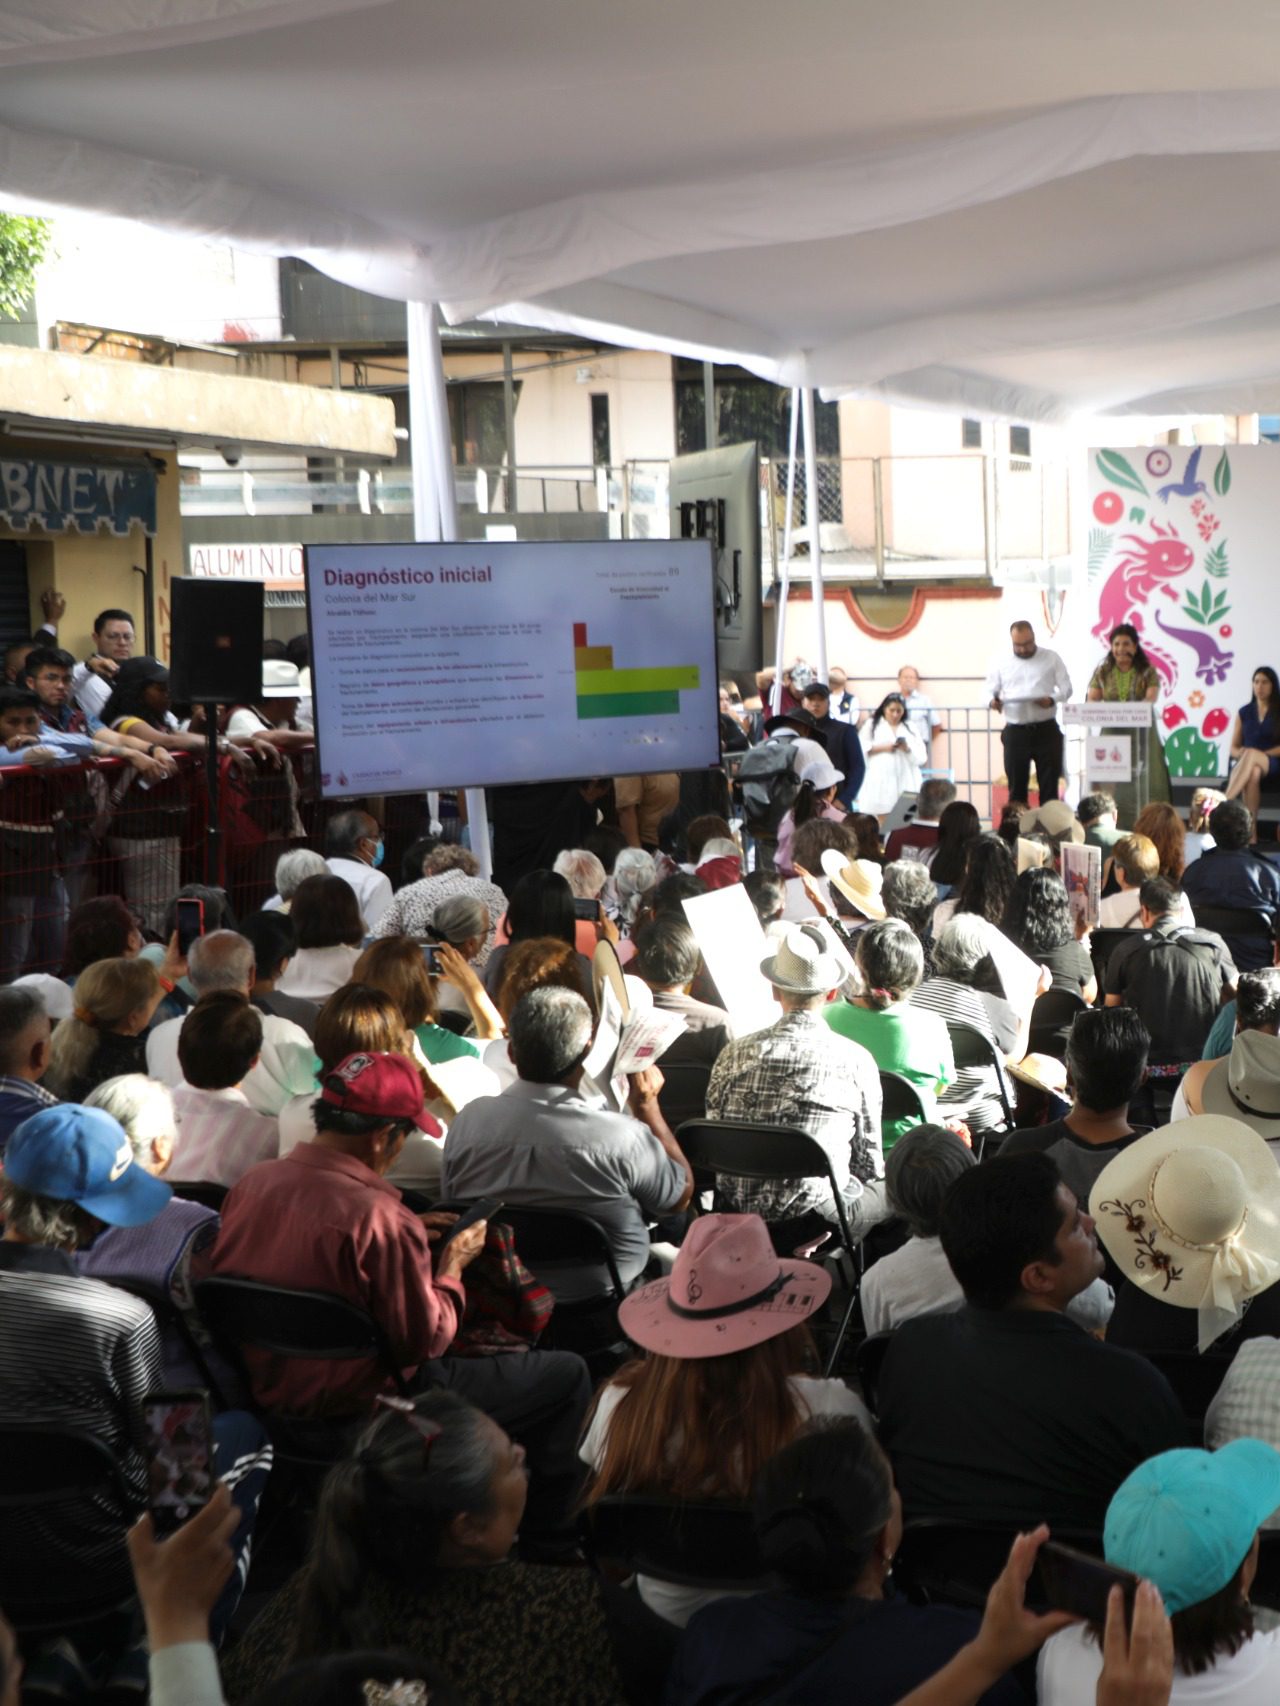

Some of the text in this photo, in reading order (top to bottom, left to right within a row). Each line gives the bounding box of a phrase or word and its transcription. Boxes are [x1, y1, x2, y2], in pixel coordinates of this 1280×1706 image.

[193, 548, 303, 577] ALUMINIO
[324, 565, 492, 589] Diagnóstico inicial
[325, 593, 416, 604] Colonia del Mar Sur
